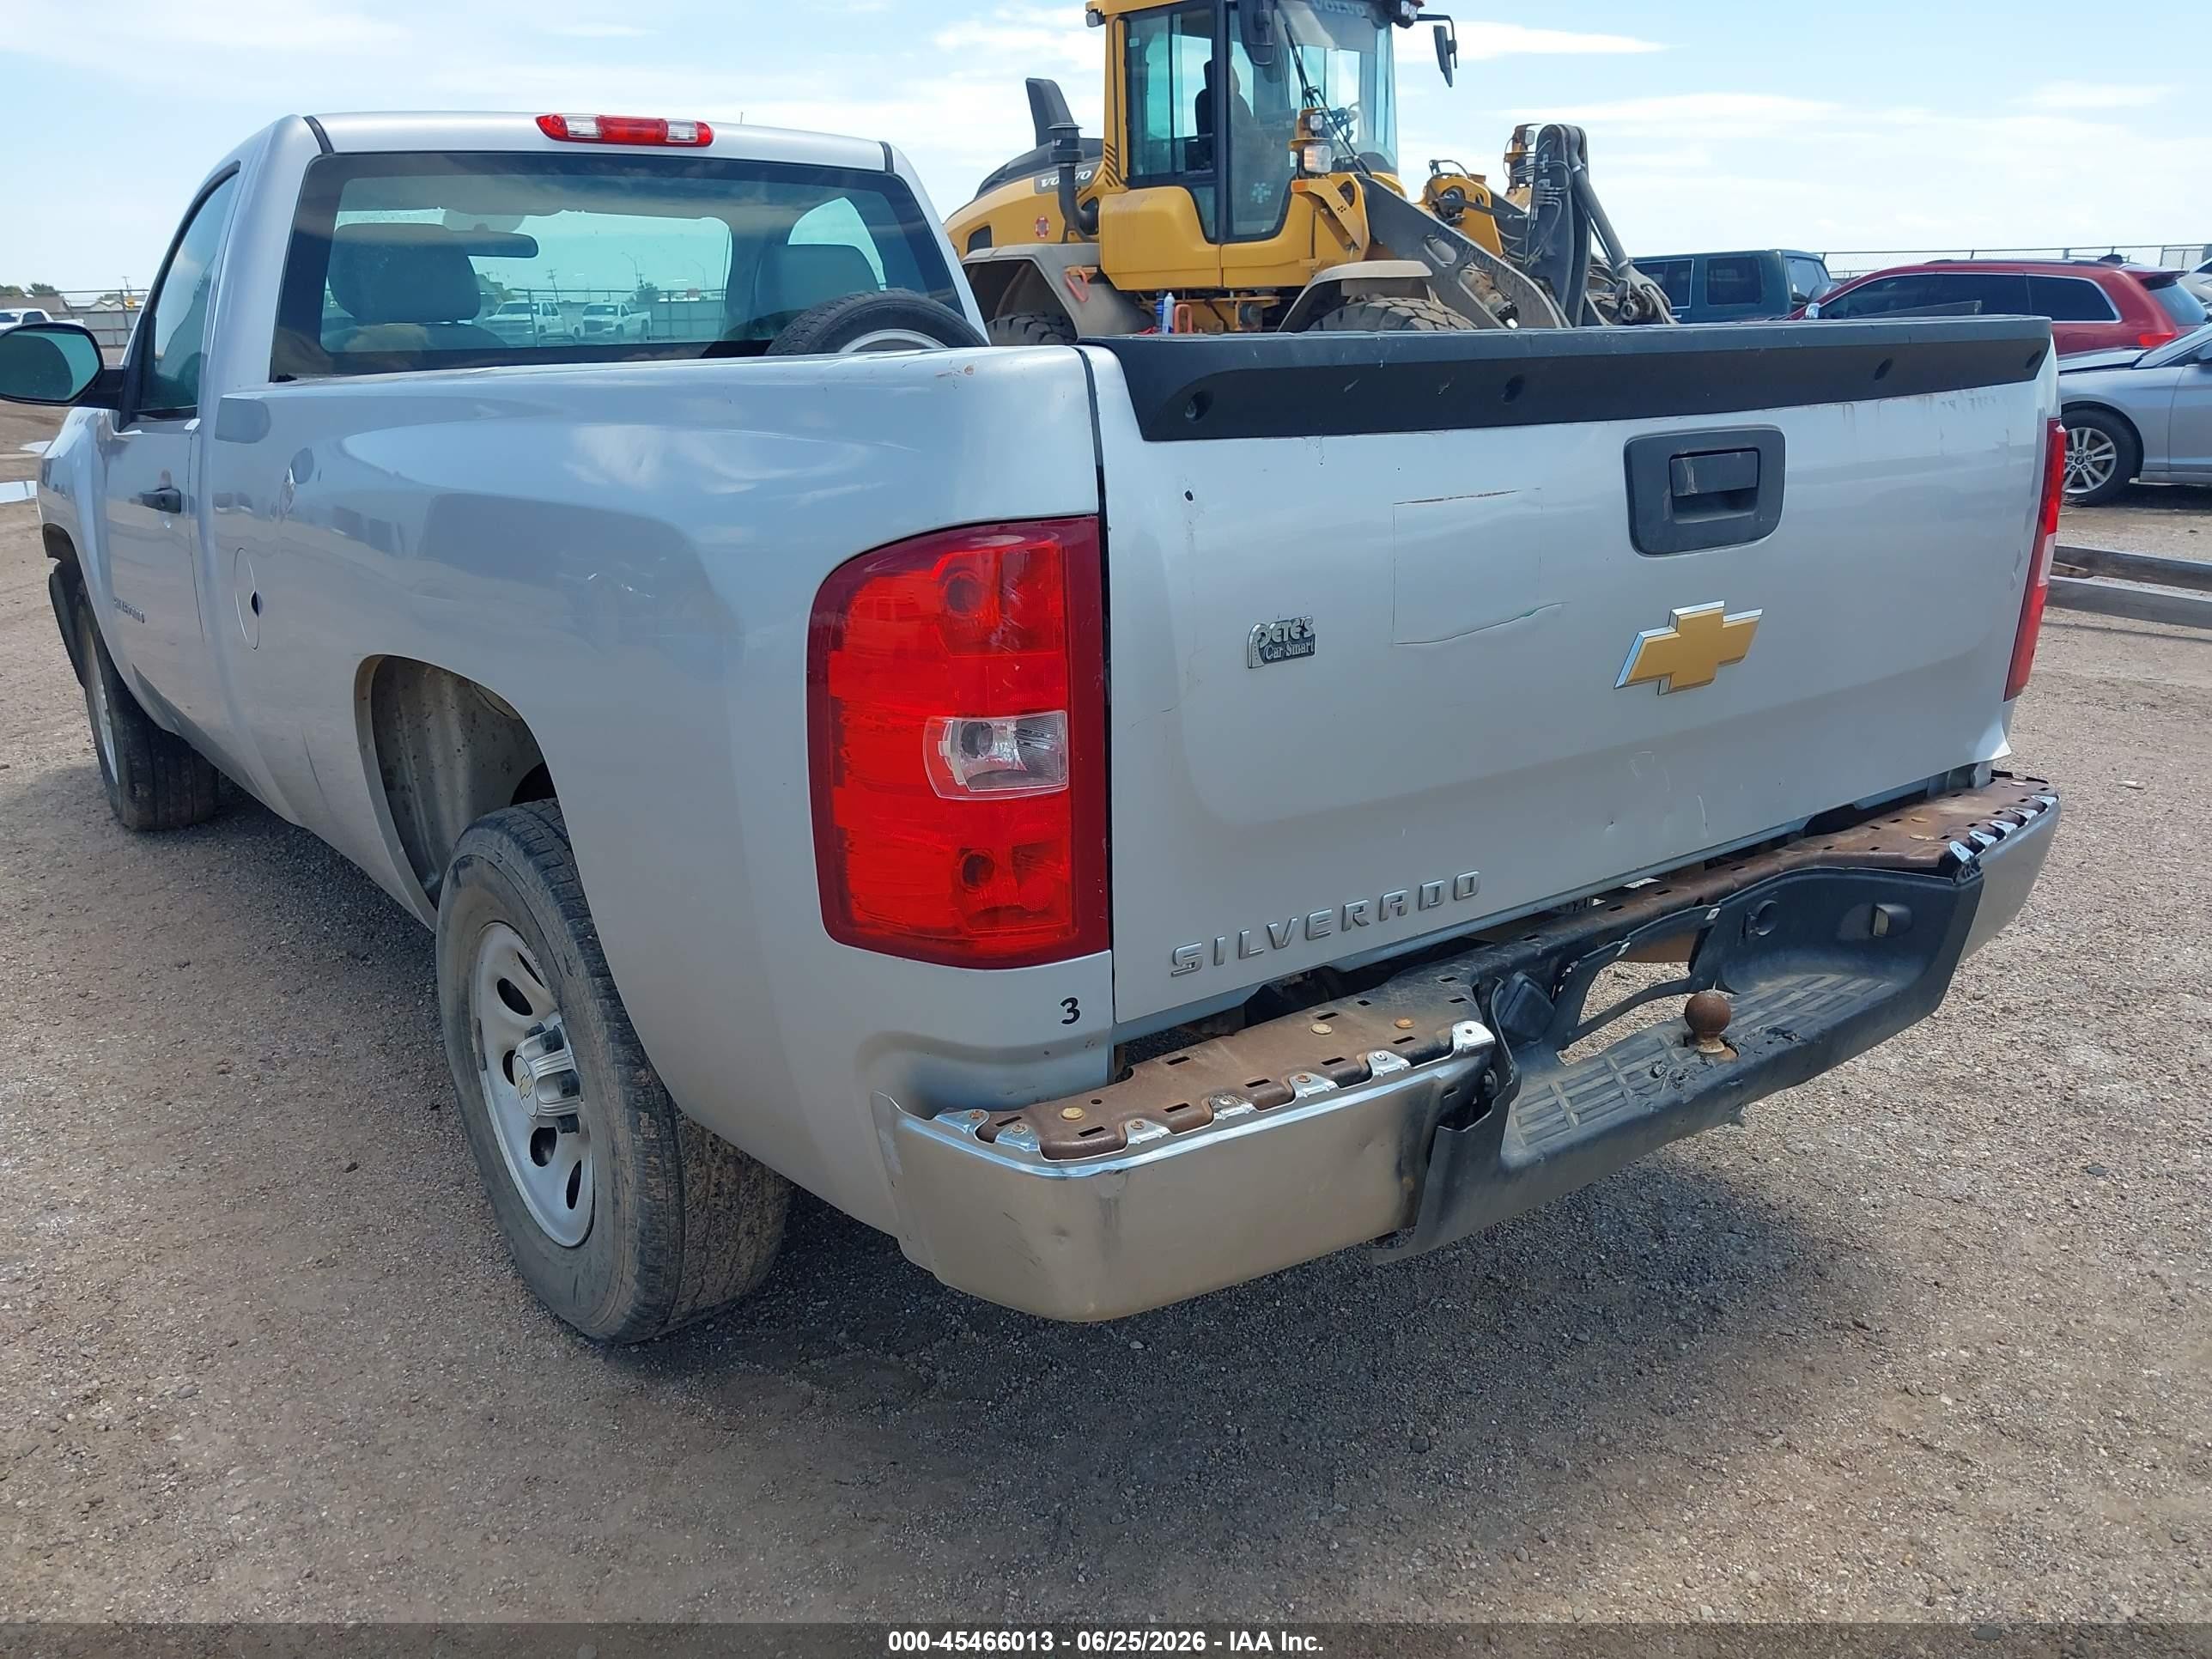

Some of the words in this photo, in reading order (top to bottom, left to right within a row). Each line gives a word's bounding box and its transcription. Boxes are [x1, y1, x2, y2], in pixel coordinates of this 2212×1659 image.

[1311, 0, 1366, 15] VOLVO
[1040, 169, 1092, 188] VOVO
[1263, 644, 1284, 661] Car
[1285, 639, 1315, 657] Smart
[1170, 870, 1480, 978] SILVERADO
[1060, 996, 1081, 1024] 3
